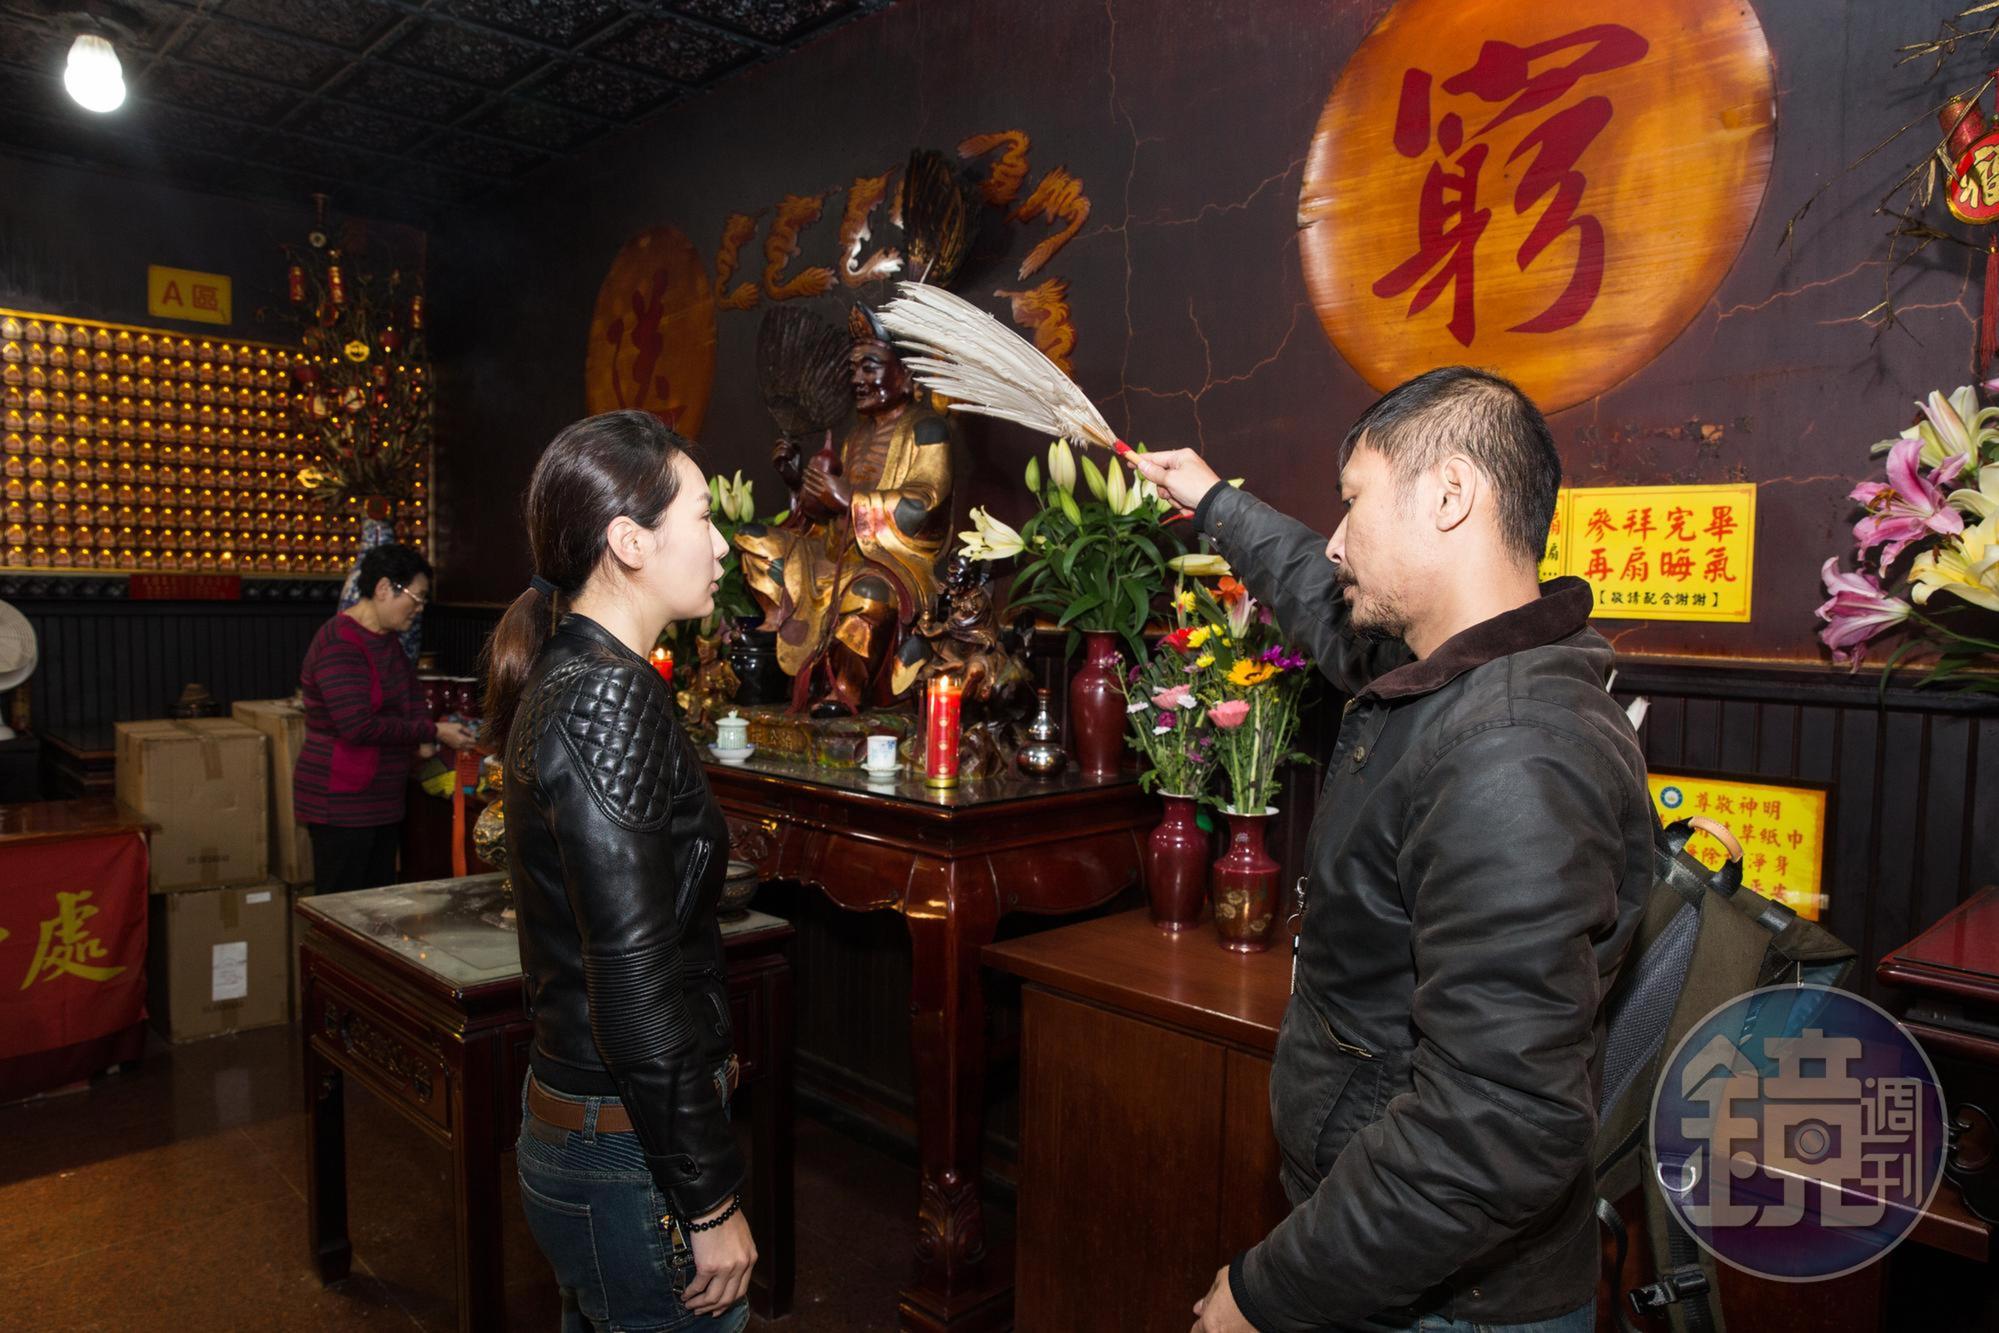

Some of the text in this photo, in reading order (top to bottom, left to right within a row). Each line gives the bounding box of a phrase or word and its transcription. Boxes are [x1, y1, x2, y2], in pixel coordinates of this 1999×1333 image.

[1584, 506, 1738, 543] 參拜完畢
[1583, 545, 1738, 584] 再扇晦氣
[1694, 792, 1782, 820] 尊敬神明
[0, 890, 128, 991] 處
